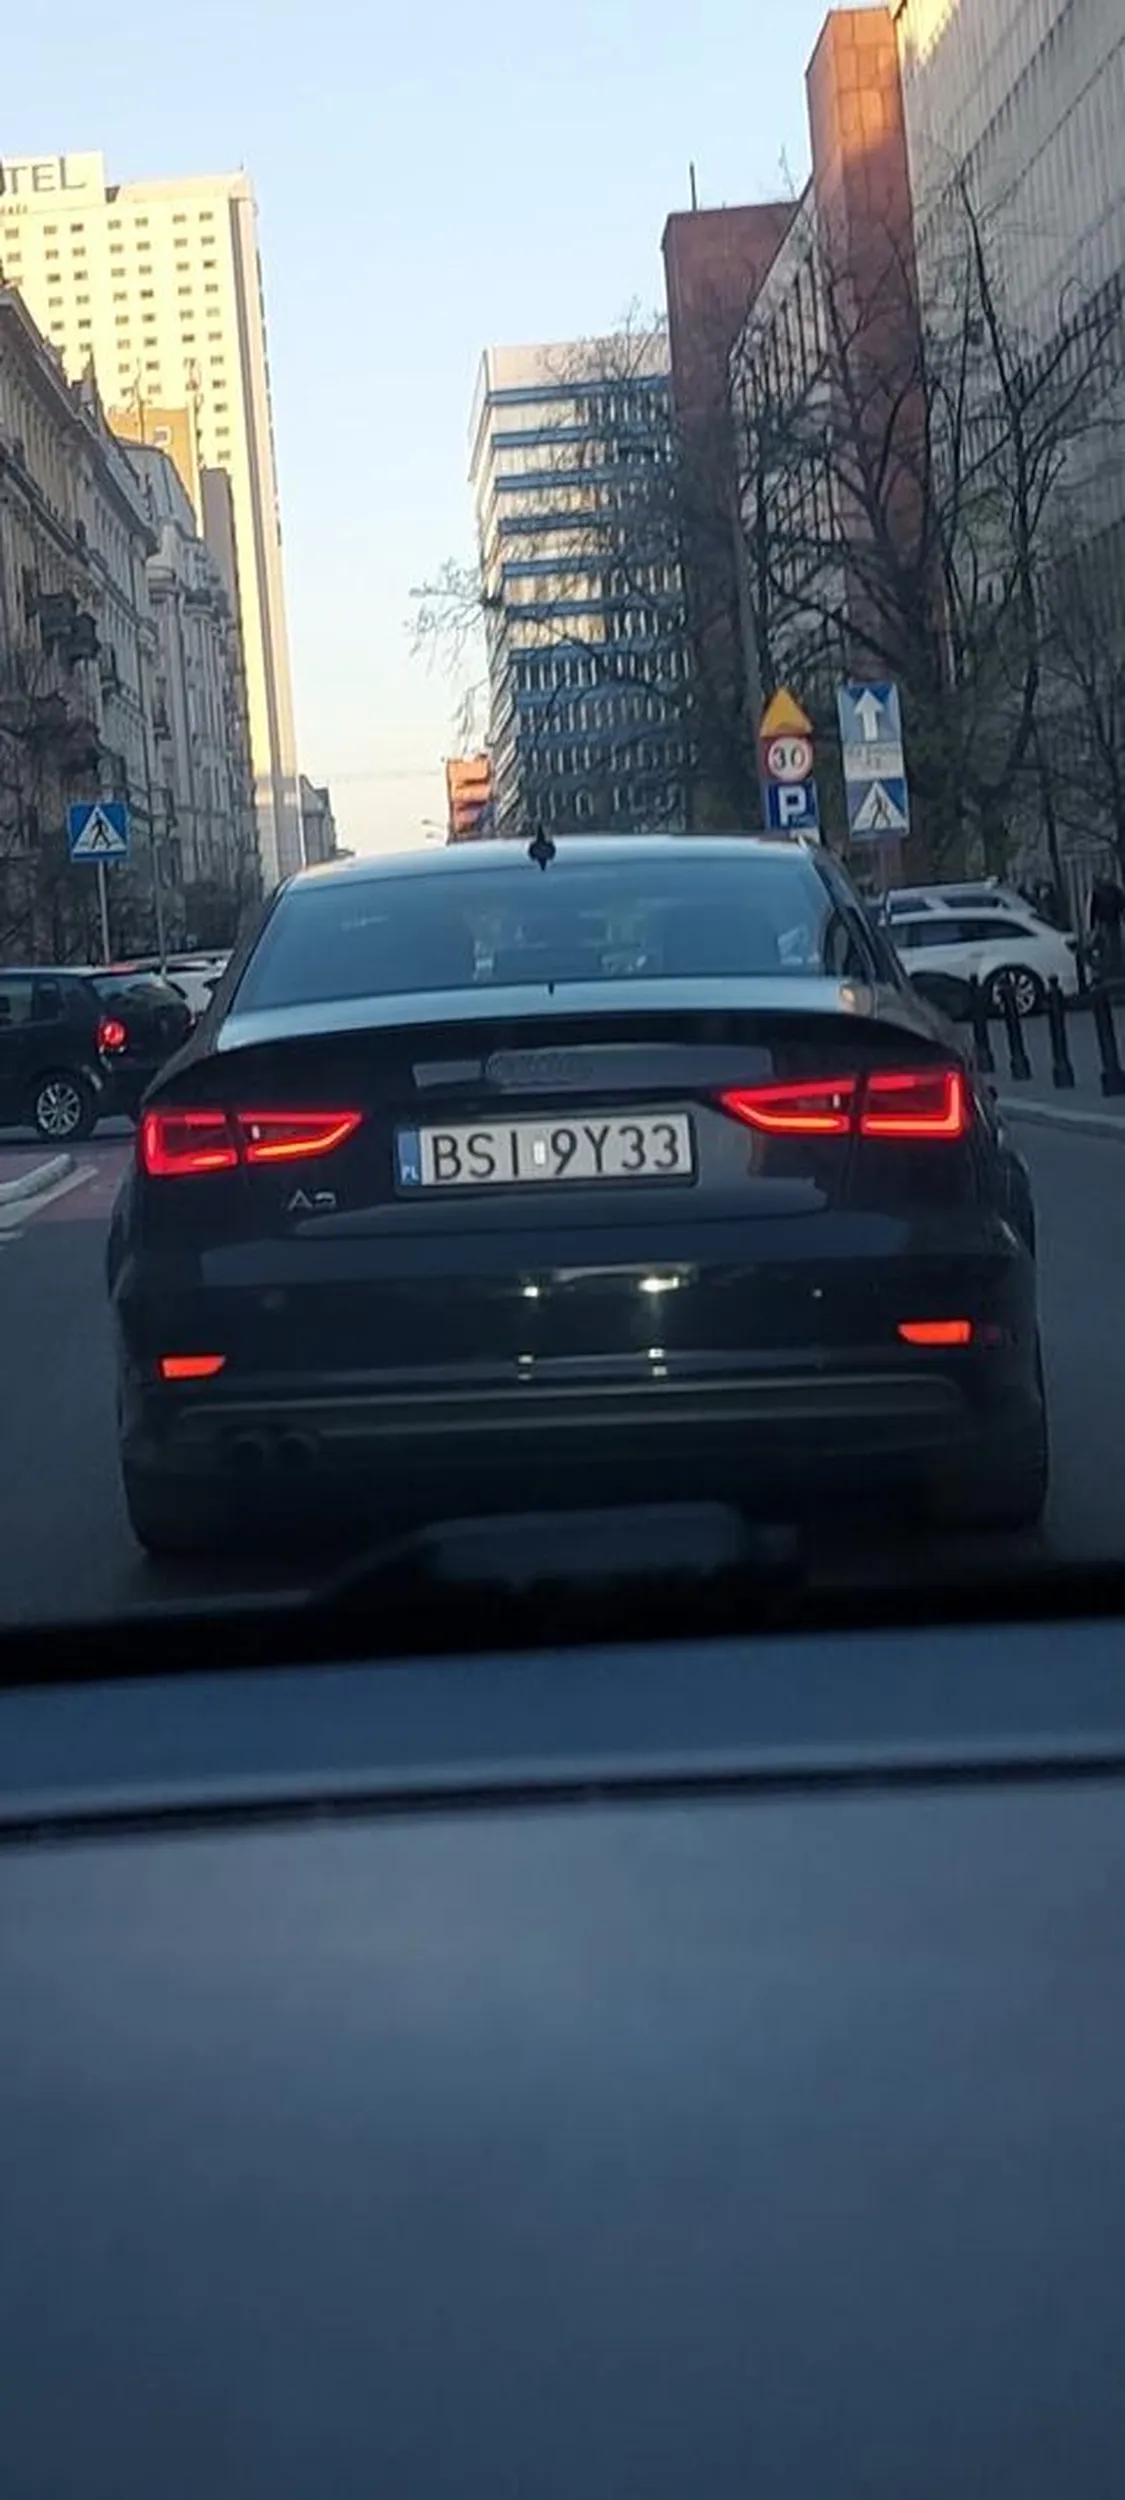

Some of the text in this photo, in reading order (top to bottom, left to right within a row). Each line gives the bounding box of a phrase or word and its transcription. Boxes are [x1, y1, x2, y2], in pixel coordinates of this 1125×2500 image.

[0, 156, 87, 196] TEL
[773, 746, 806, 773] 30
[778, 786, 807, 827] P
[431, 1123, 680, 1181] BSI 9Y33
[402, 1165, 419, 1181] PL
